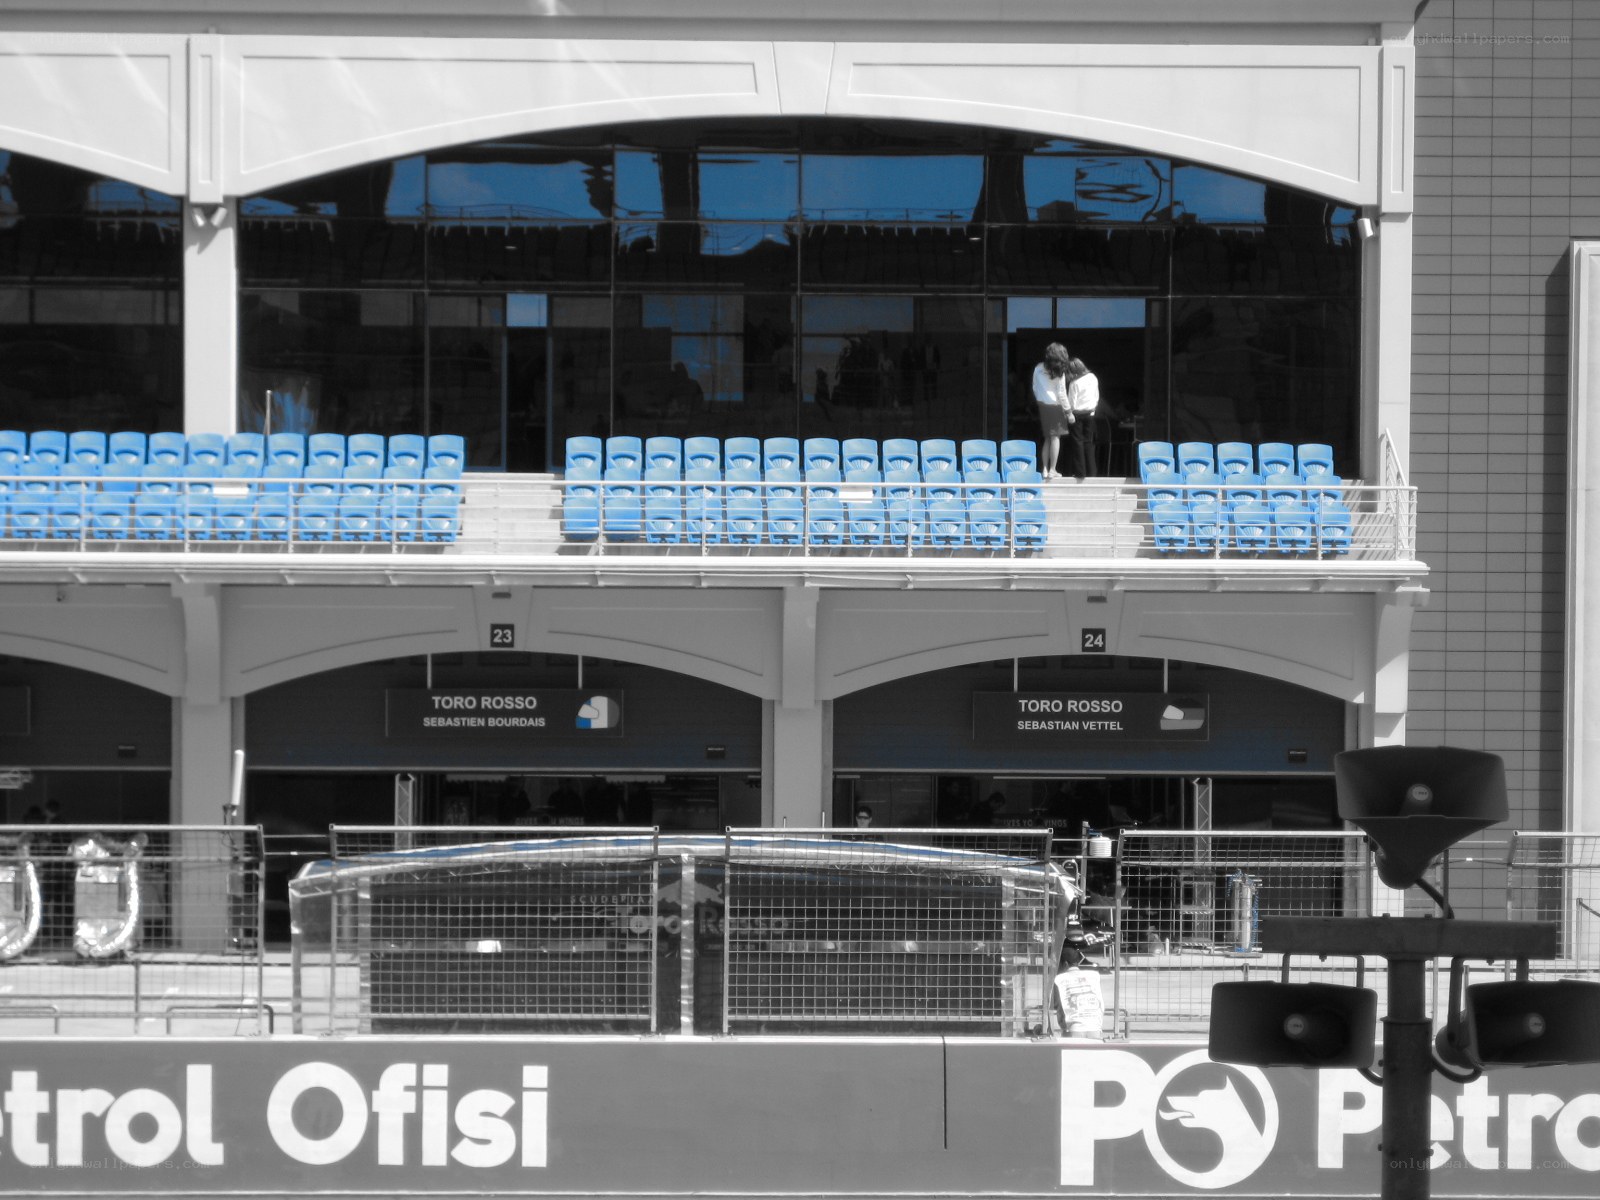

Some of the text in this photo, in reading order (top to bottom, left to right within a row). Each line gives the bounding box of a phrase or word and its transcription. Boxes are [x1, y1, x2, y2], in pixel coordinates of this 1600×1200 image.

[493, 629, 513, 643] 23
[1084, 633, 1104, 647] 24
[432, 696, 537, 710] TORO ROSSO
[1019, 699, 1123, 713] TORO ROSSO
[423, 717, 546, 727] SEBASTIEN BOURDAIS
[1017, 720, 1124, 731] SEBASTIAN VETTEL
[569, 894, 645, 905] SCUDERIA
[613, 906, 682, 935] Toro
[0, 1062, 548, 1168] trol Ofisi
